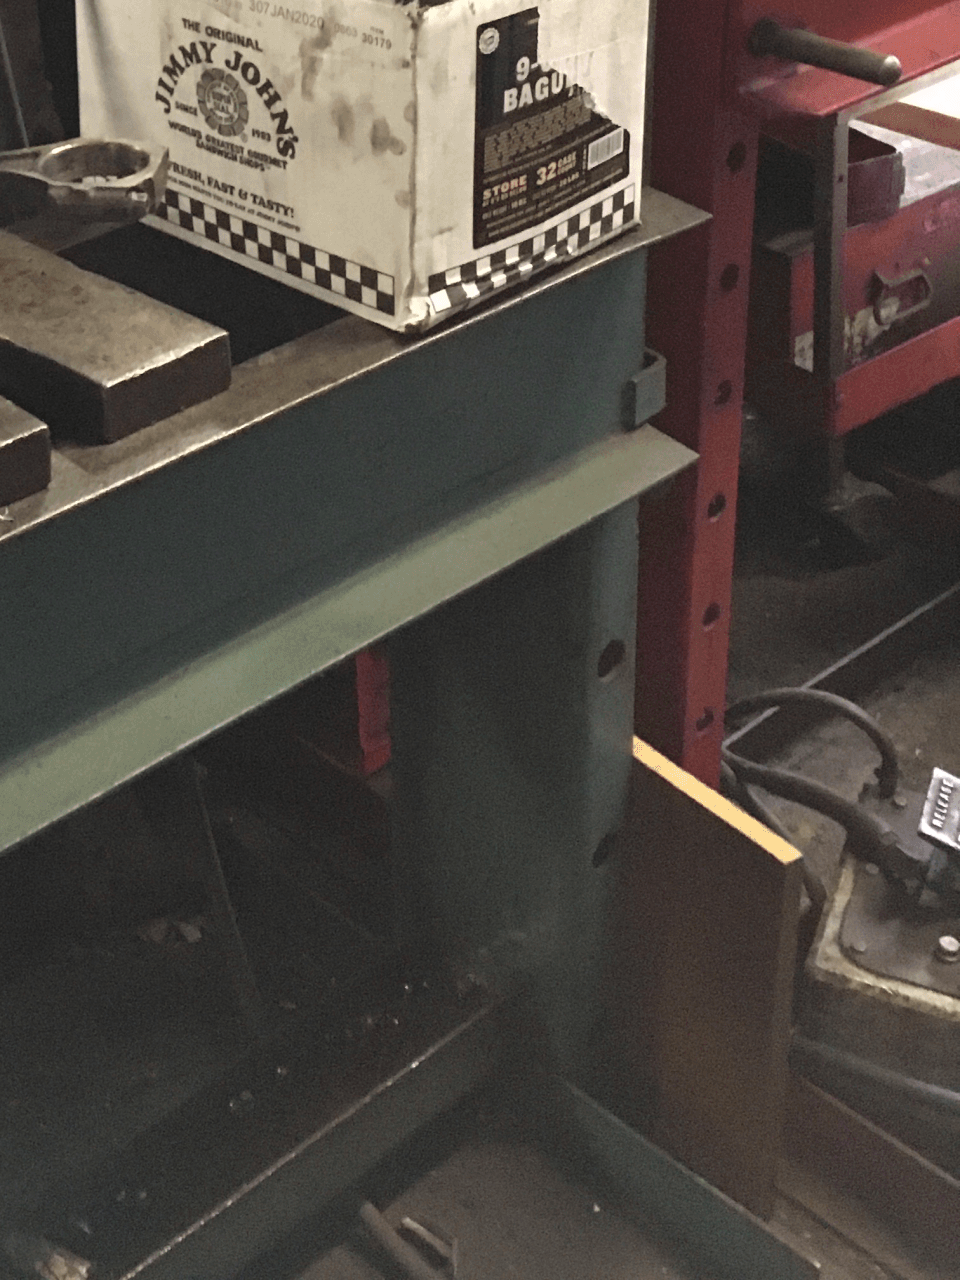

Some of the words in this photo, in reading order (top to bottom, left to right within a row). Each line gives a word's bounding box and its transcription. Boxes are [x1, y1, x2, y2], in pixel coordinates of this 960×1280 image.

[182, 18, 201, 33] THE
[204, 25, 263, 53] ORIGINAL
[361, 32, 392, 50] 30179
[155, 40, 217, 114] JIMMY
[224, 50, 300, 160] JOHN'S
[482, 174, 528, 200] STORE
[536, 161, 557, 186] 32
[206, 175, 236, 196] FAST
[238, 188, 248, 201] &
[250, 192, 295, 219] TASTY!
